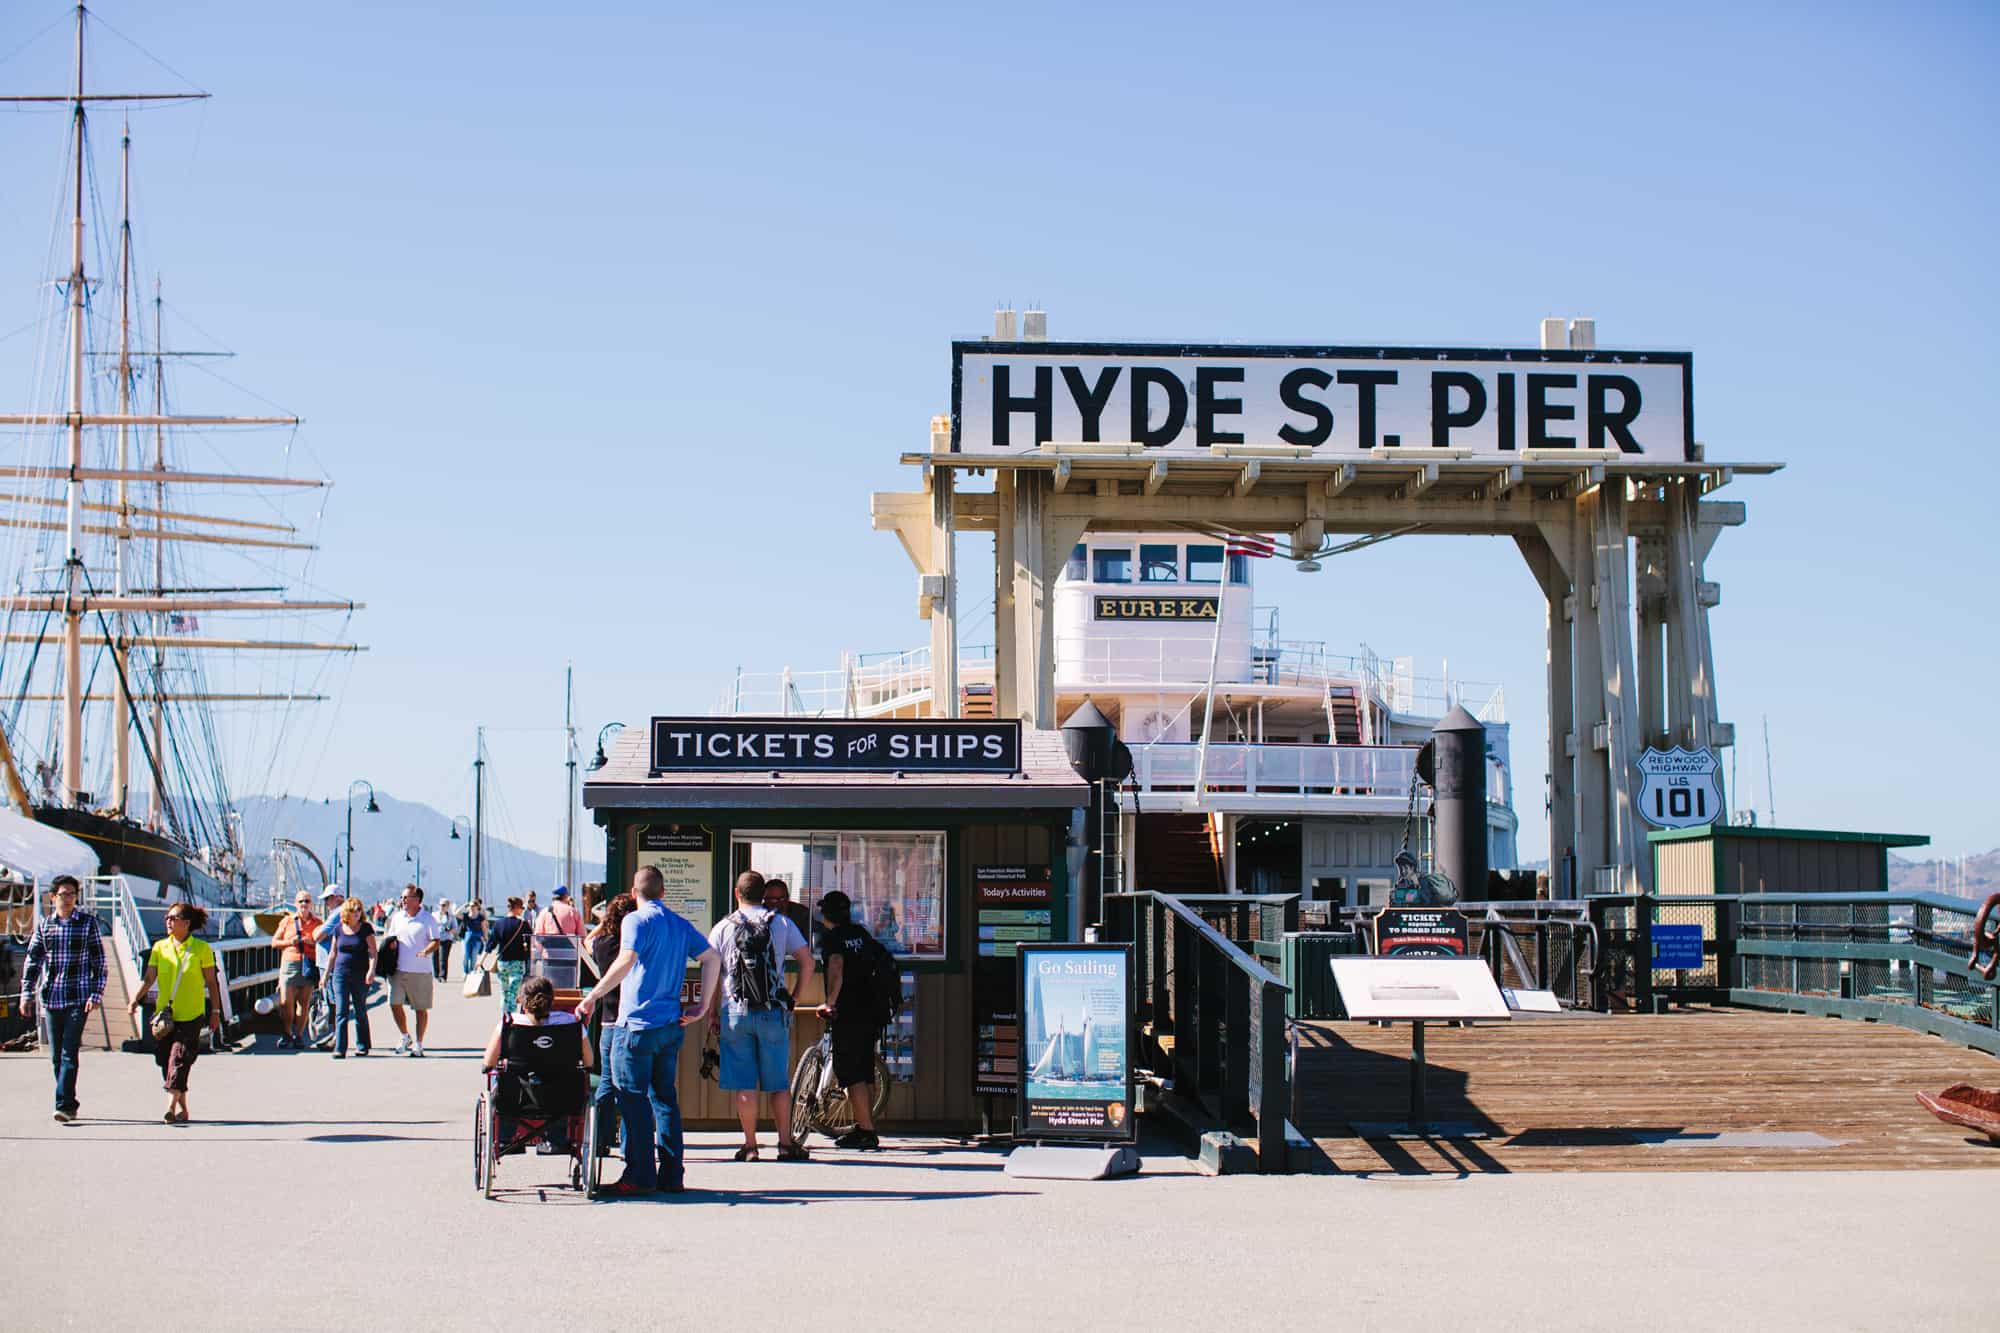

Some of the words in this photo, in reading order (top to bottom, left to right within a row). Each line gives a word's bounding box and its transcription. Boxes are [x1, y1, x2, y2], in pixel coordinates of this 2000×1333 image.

[992, 364, 1245, 448] HYDE
[1278, 367, 1401, 449] ST.
[1431, 370, 1645, 454] PIER
[1100, 600, 1218, 617] EUREKA
[670, 732, 834, 759] TICKETS
[848, 733, 878, 758] FOR
[889, 734, 1003, 759] SHIPS
[1648, 756, 1709, 764] REDWOOD
[1656, 788, 1706, 817] 101
[983, 887, 1010, 899] Today's
[1011, 888, 1047, 897] Activities
[1400, 914, 1442, 922] TICKET
[1039, 959, 1061, 975] Go
[1065, 959, 1117, 977] Sailing
[1048, 1116, 1067, 1126] Hyde
[1068, 1116, 1089, 1125] Street
[1090, 1117, 1104, 1126] Pier
